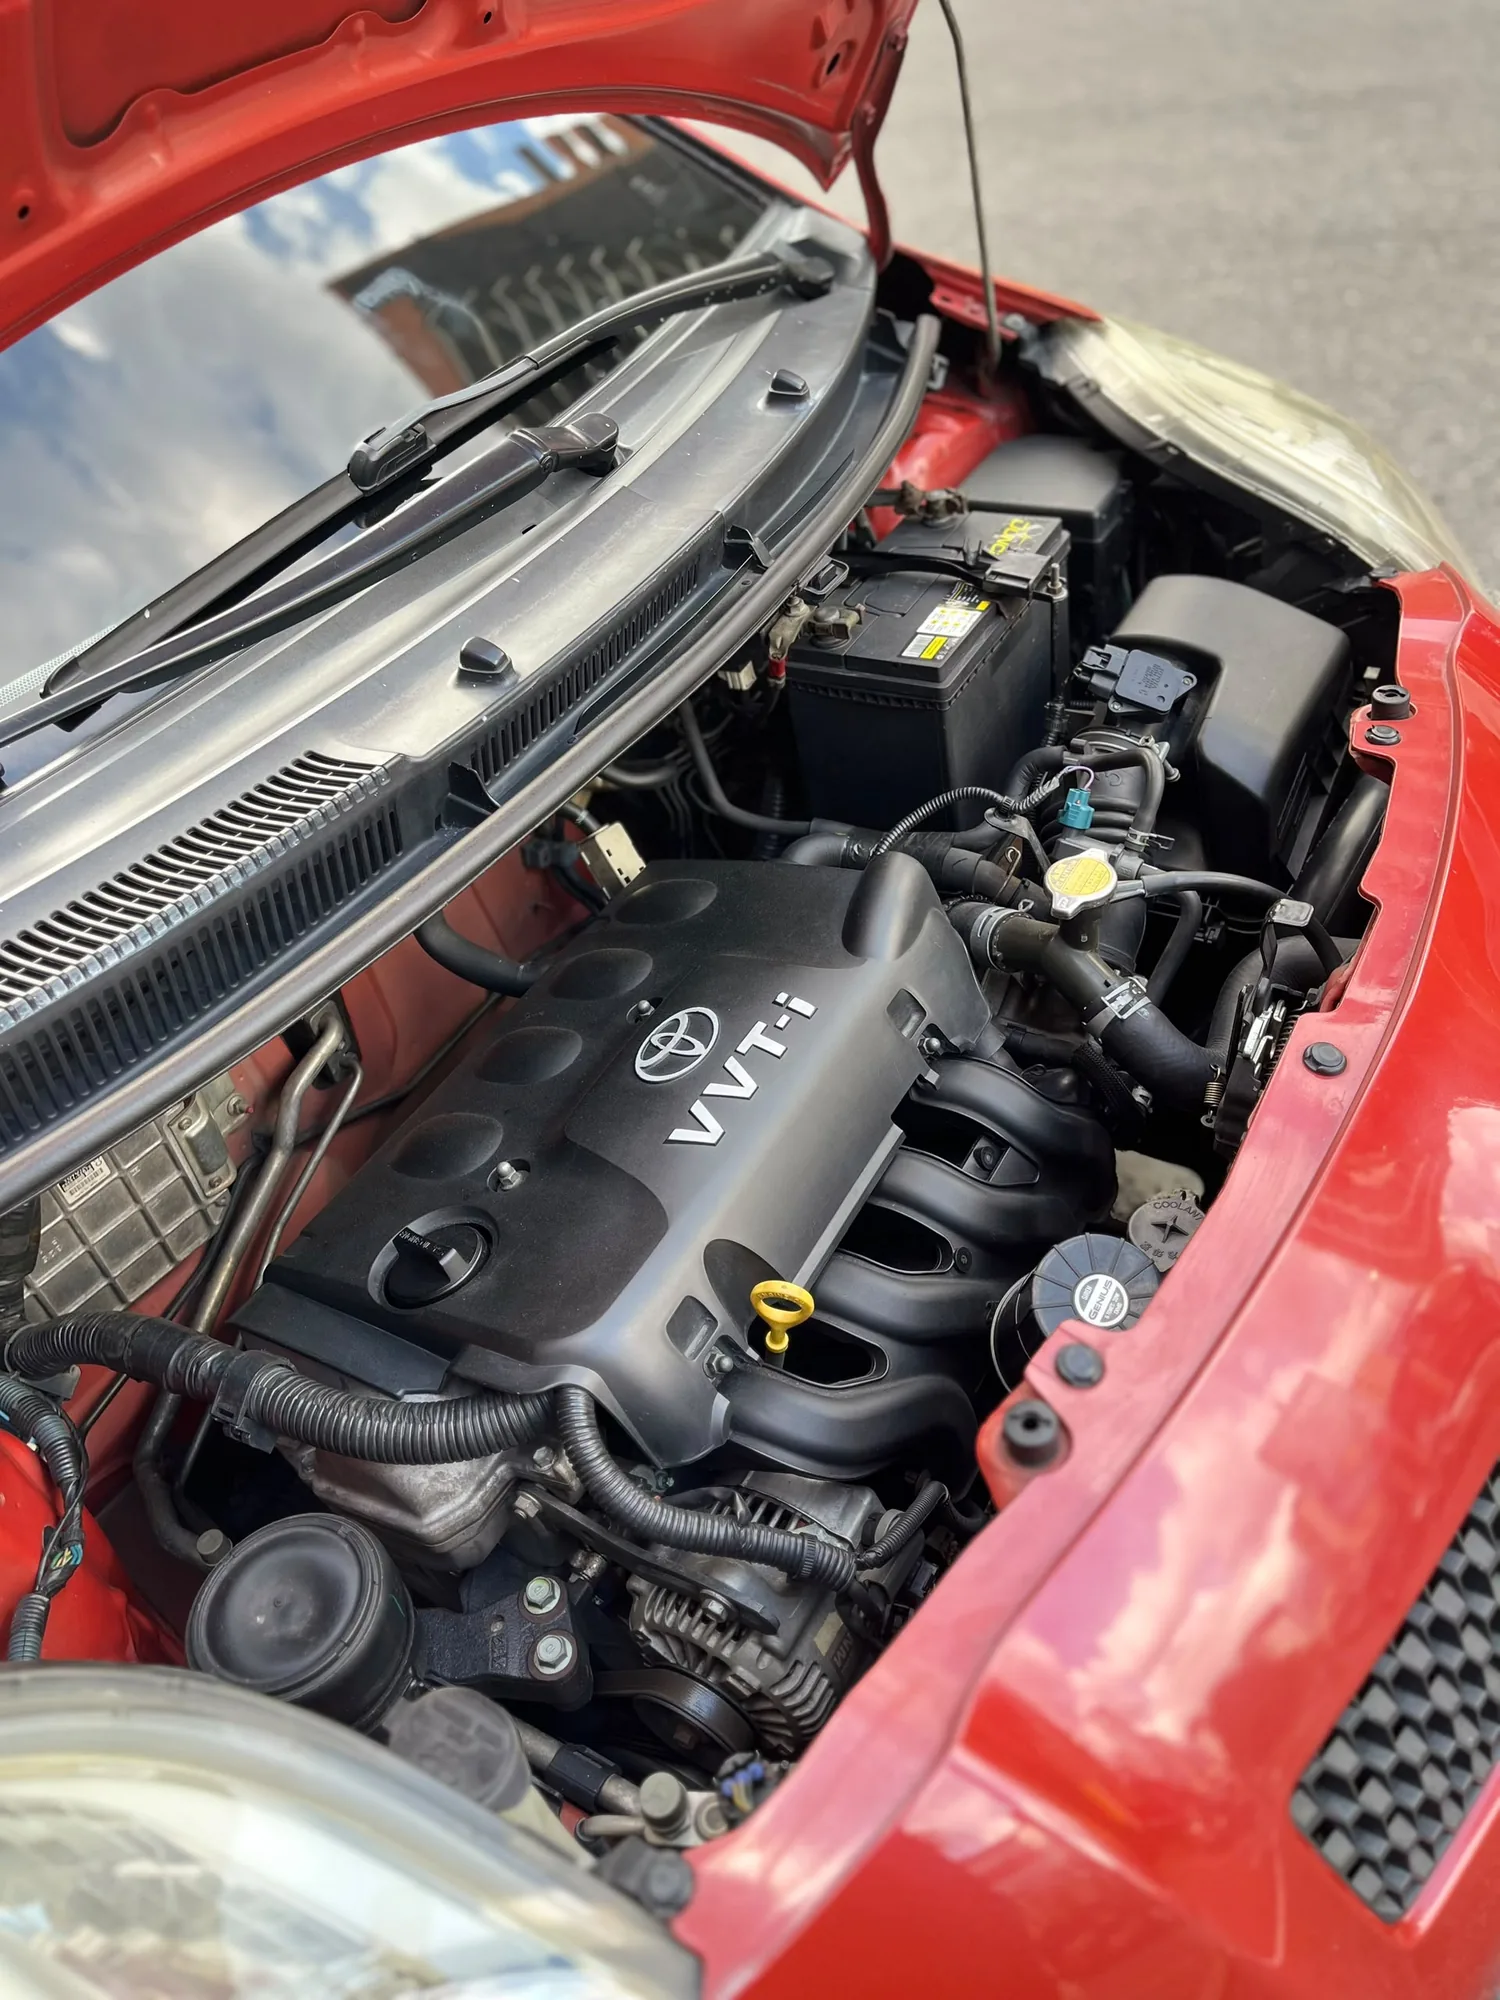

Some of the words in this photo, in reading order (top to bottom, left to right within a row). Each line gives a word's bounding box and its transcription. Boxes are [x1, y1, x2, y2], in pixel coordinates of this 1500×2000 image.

[666, 991, 817, 1145] VVT-i
[1153, 1201, 1204, 1220] COOLANT
[1088, 1279, 1113, 1320] GENIUS
